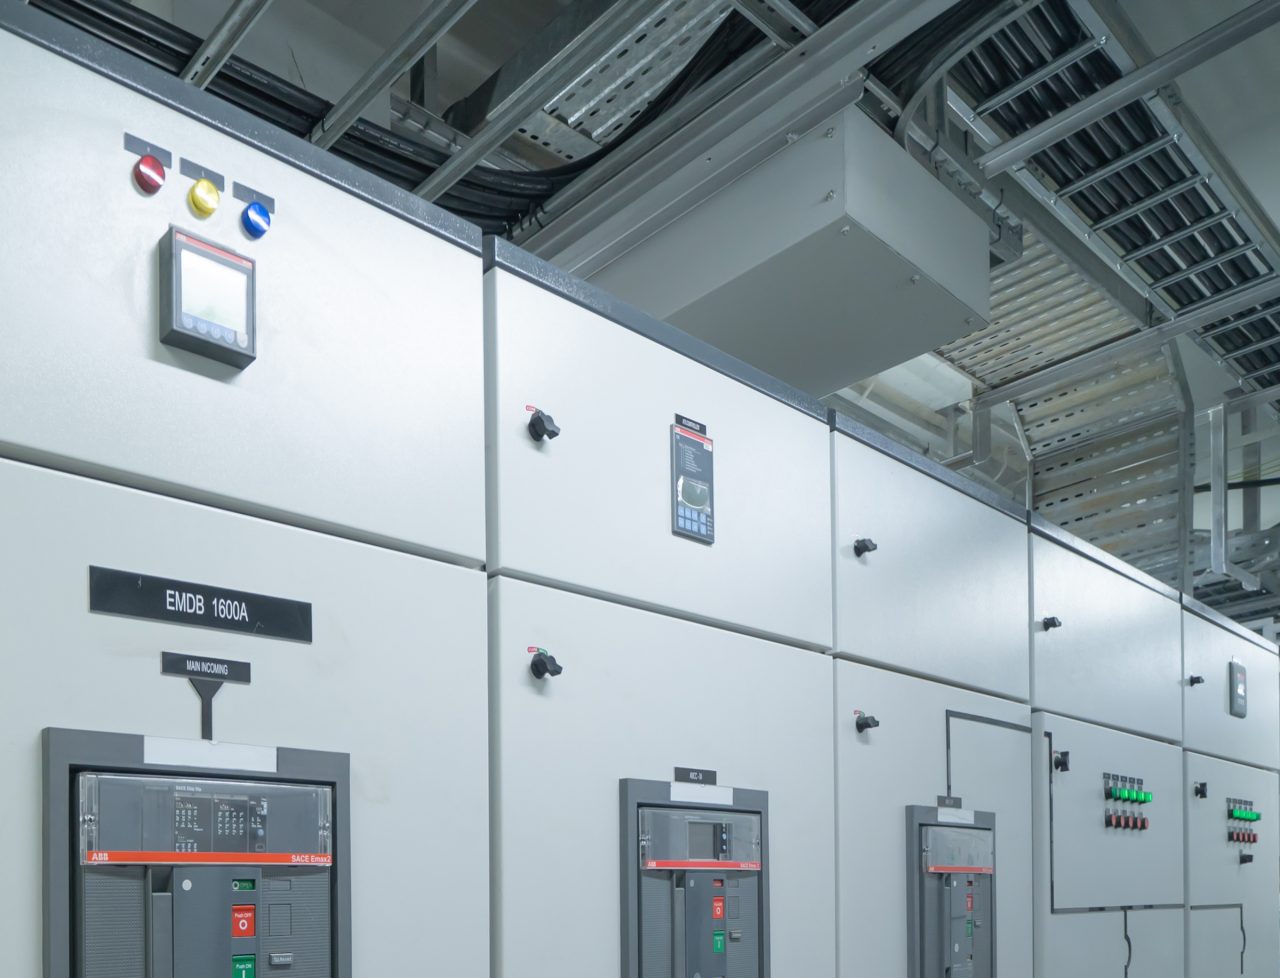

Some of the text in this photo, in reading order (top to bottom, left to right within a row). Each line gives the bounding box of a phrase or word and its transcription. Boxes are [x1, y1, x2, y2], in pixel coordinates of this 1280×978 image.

[166, 589, 249, 622] EMDB 1600A
[186, 659, 229, 676] MAIN INCOMING
[91, 852, 109, 861] ABB
[291, 855, 309, 863] SACE
